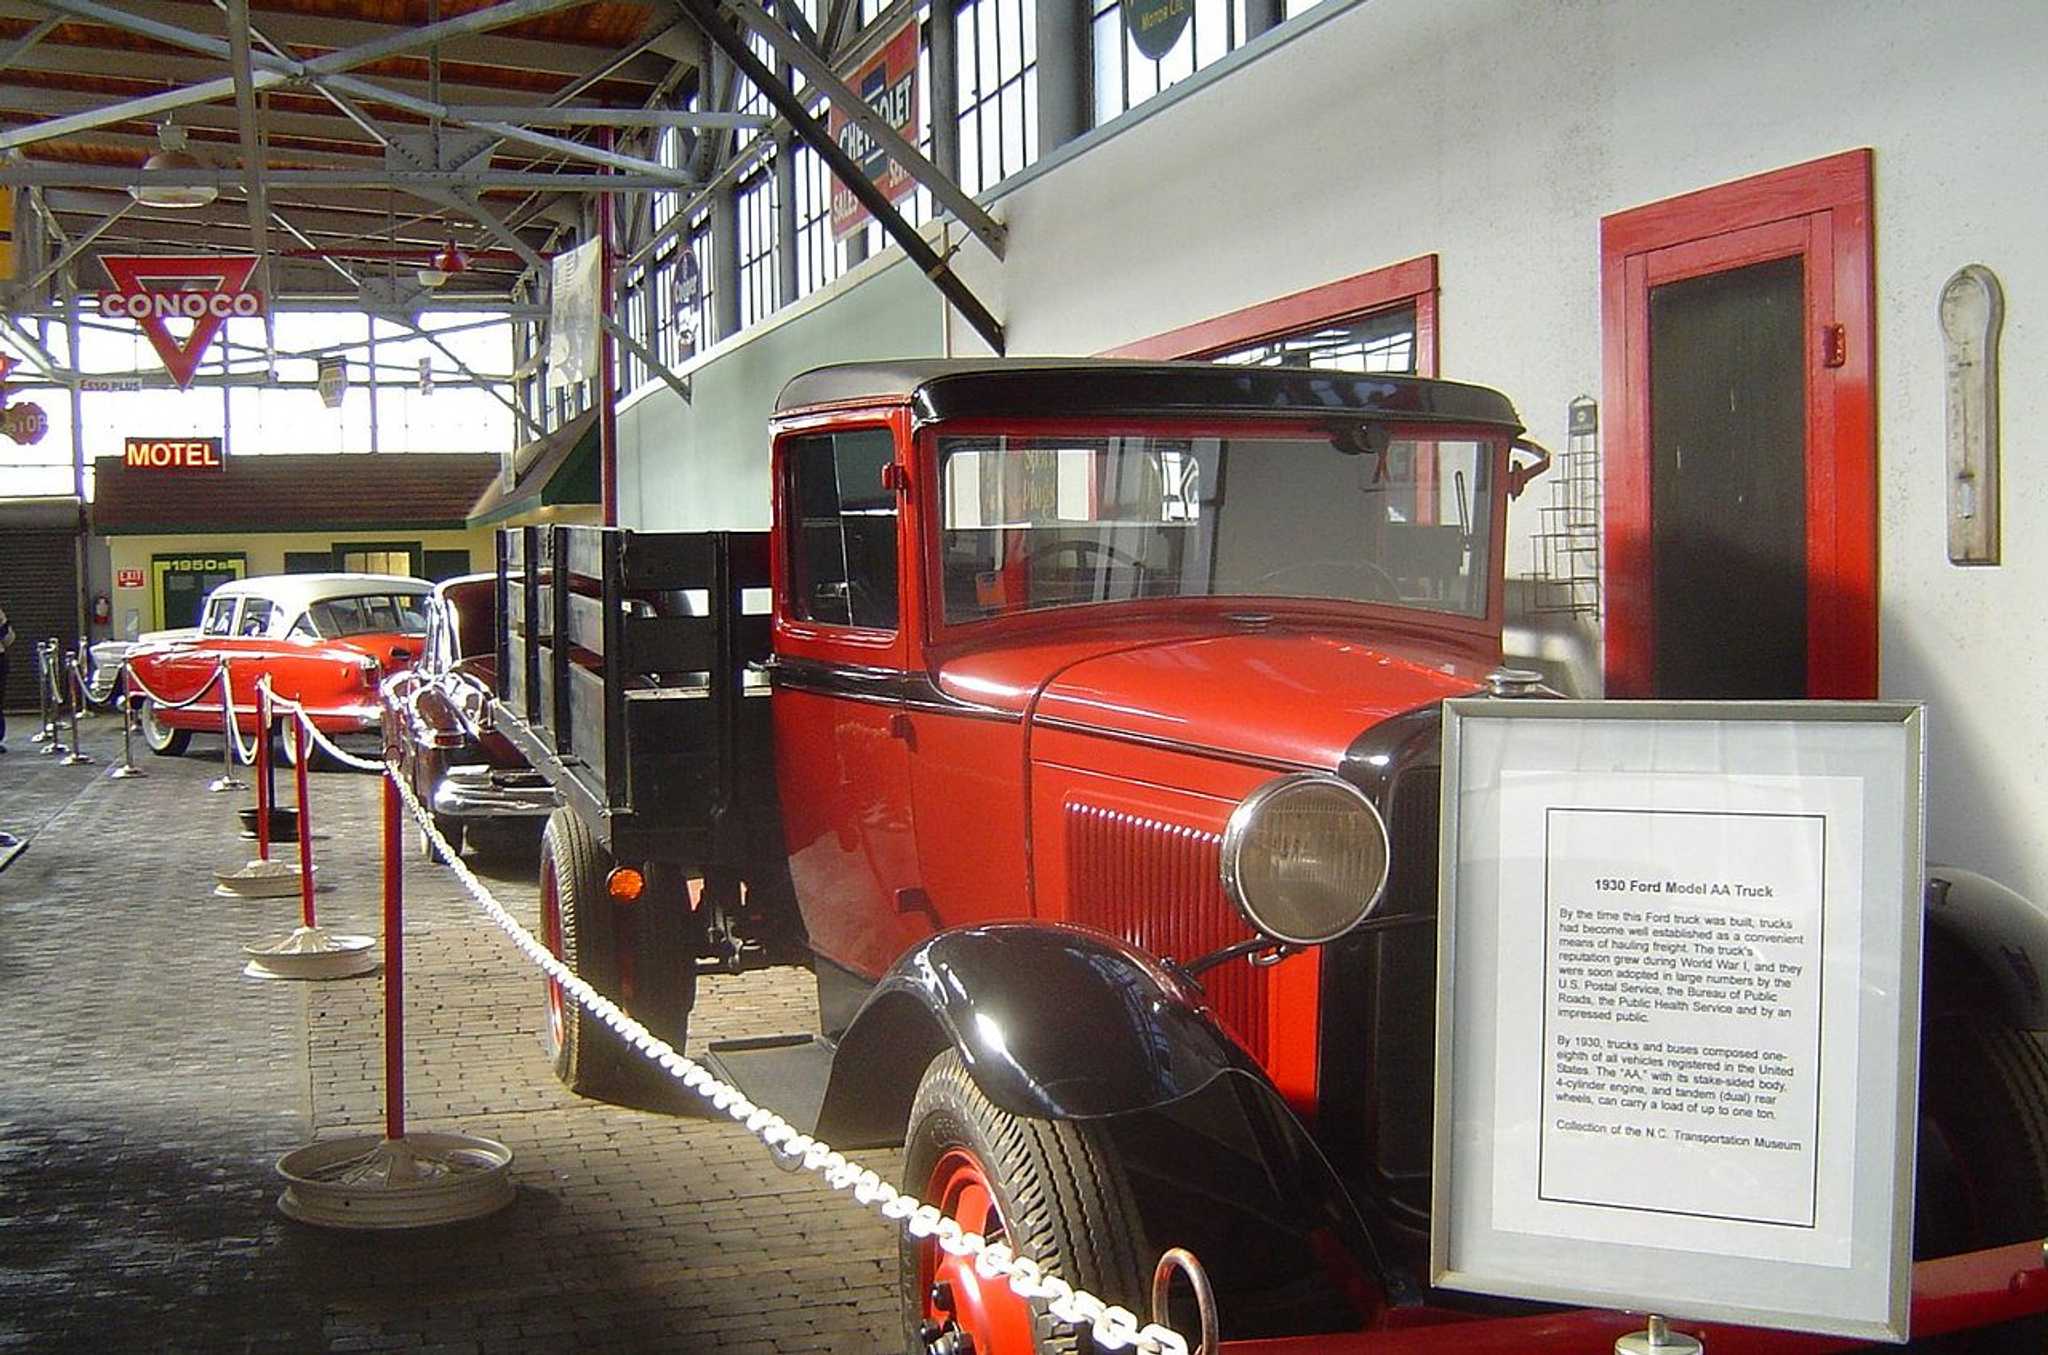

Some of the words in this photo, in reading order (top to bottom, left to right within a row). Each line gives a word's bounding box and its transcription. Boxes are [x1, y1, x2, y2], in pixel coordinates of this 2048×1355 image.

[102, 293, 258, 318] CONOCO
[127, 443, 219, 465] MOTEL
[1595, 880, 1625, 891] 1930
[1630, 880, 1660, 892] Ford
[1666, 883, 1707, 895] Model
[1710, 885, 1730, 895] AA
[1735, 885, 1773, 897] Truck
[1560, 909, 1573, 920] By
[1577, 910, 1593, 919] the
[1597, 911, 1619, 921] time
[1623, 912, 1641, 922] this
[1646, 913, 1670, 923] Ford
[1674, 914, 1700, 925] truck
[1704, 917, 1726, 926] was
[1729, 916, 1754, 928] built,
[1759, 919, 1793, 929] trucks
[1559, 923, 1579, 933] had
[1582, 924, 1624, 935] become
[1628, 926, 1649, 936] well
[1652, 927, 1712, 940] established
[1716, 932, 1729, 940] as
[1733, 933, 1740, 941] a
[1744, 933, 1803, 944] convenient
[1559, 938, 1594, 948] means
[1597, 939, 1609, 949] of
[1612, 939, 1648, 952] hauling
[1652, 941, 1688, 954] freight.
[1694, 944, 1714, 954] The
[1717, 944, 1753, 956] truck's
[1558, 951, 1610, 963] reputation
[1614, 955, 1639, 965] grew
[1643, 956, 1676, 968] during
[1680, 958, 1712, 968] World
[1716, 959, 1739, 970] War
[1743, 962, 1749, 972] I,
[1754, 962, 1775, 972] and
[1779, 963, 1802, 976] they
[1558, 968, 1584, 976] were
[1588, 969, 1613, 977] soon
[1616, 969, 1659, 982] adopted
[1663, 972, 1672, 981] in
[1676, 972, 1701, 984] large
[1706, 974, 1753, 986] numbers
[1757, 976, 1770, 988] by
[1774, 978, 1791, 988] the
[1558, 979, 1579, 990] U.S.
[1585, 981, 1617, 992] Postal
[1621, 983, 1662, 996] Service,
[1667, 985, 1683, 996] the
[1688, 987, 1726, 998] Bureau
[1729, 989, 1741, 999] of
[1744, 990, 1777, 1002] Public
[1558, 1008, 1612, 1021] impressed
[1616, 1011, 1648, 1022] public.
[1600, 995, 1615, 1006] the
[1619, 997, 1650, 1008] Public
[1655, 1000, 1689, 1010] Health
[1693, 1002, 1732, 1013] Service
[1736, 1004, 1757, 1014] and
[1761, 1006, 1774, 1018] by
[1778, 1008, 1791, 1017] an
[1558, 1035, 1570, 1047] By
[1575, 1037, 1603, 1049] 1930,
[1607, 1040, 1639, 1050] trucks
[1643, 1041, 1662, 1052] and
[1667, 1043, 1698, 1054] buses
[1702, 1045, 1758, 1060] composed
[1557, 1050, 1588, 1062] eighth
[1592, 1052, 1603, 1062] of
[1606, 1053, 1617, 1063] all
[1621, 1055, 1663, 1066] vehicles
[1667, 1058, 1720, 1071] registered
[1724, 1062, 1734, 1071] in
[1738, 1063, 1754, 1073] the
[1759, 1065, 1794, 1076] United
[1597, 1067, 1616, 1077] The
[1651, 1072, 1673, 1082] with
[1677, 1073, 1689, 1083] its
[1693, 1074, 1754, 1087] stake-sided
[1556, 1078, 1606, 1090] 4-cylinder
[1610, 1083, 1647, 1096] engine,
[1652, 1086, 1672, 1097] and
[1676, 1088, 1715, 1099] tandem
[1720, 1091, 1750, 1103] (dual)
[1754, 1095, 1776, 1104] rear
[1555, 1093, 1594, 1105] wheels,
[1599, 1097, 1617, 1105] can
[1621, 1098, 1647, 1110] carry
[1651, 1100, 1658, 1109] a
[1661, 1101, 1683, 1111] load
[1687, 1102, 1698, 1112] of
[1701, 1105, 1715, 1115] up
[1718, 1105, 1729, 1115] to
[1732, 1108, 1753, 1117] one
[1757, 1108, 1776, 1118] ton.
[1556, 1120, 1606, 1132] Collection
[1611, 1124, 1622, 1135] of
[1625, 1125, 1642, 1136] the
[1673, 1130, 1750, 1145] Transportation
[1754, 1138, 1802, 1150] Museum
